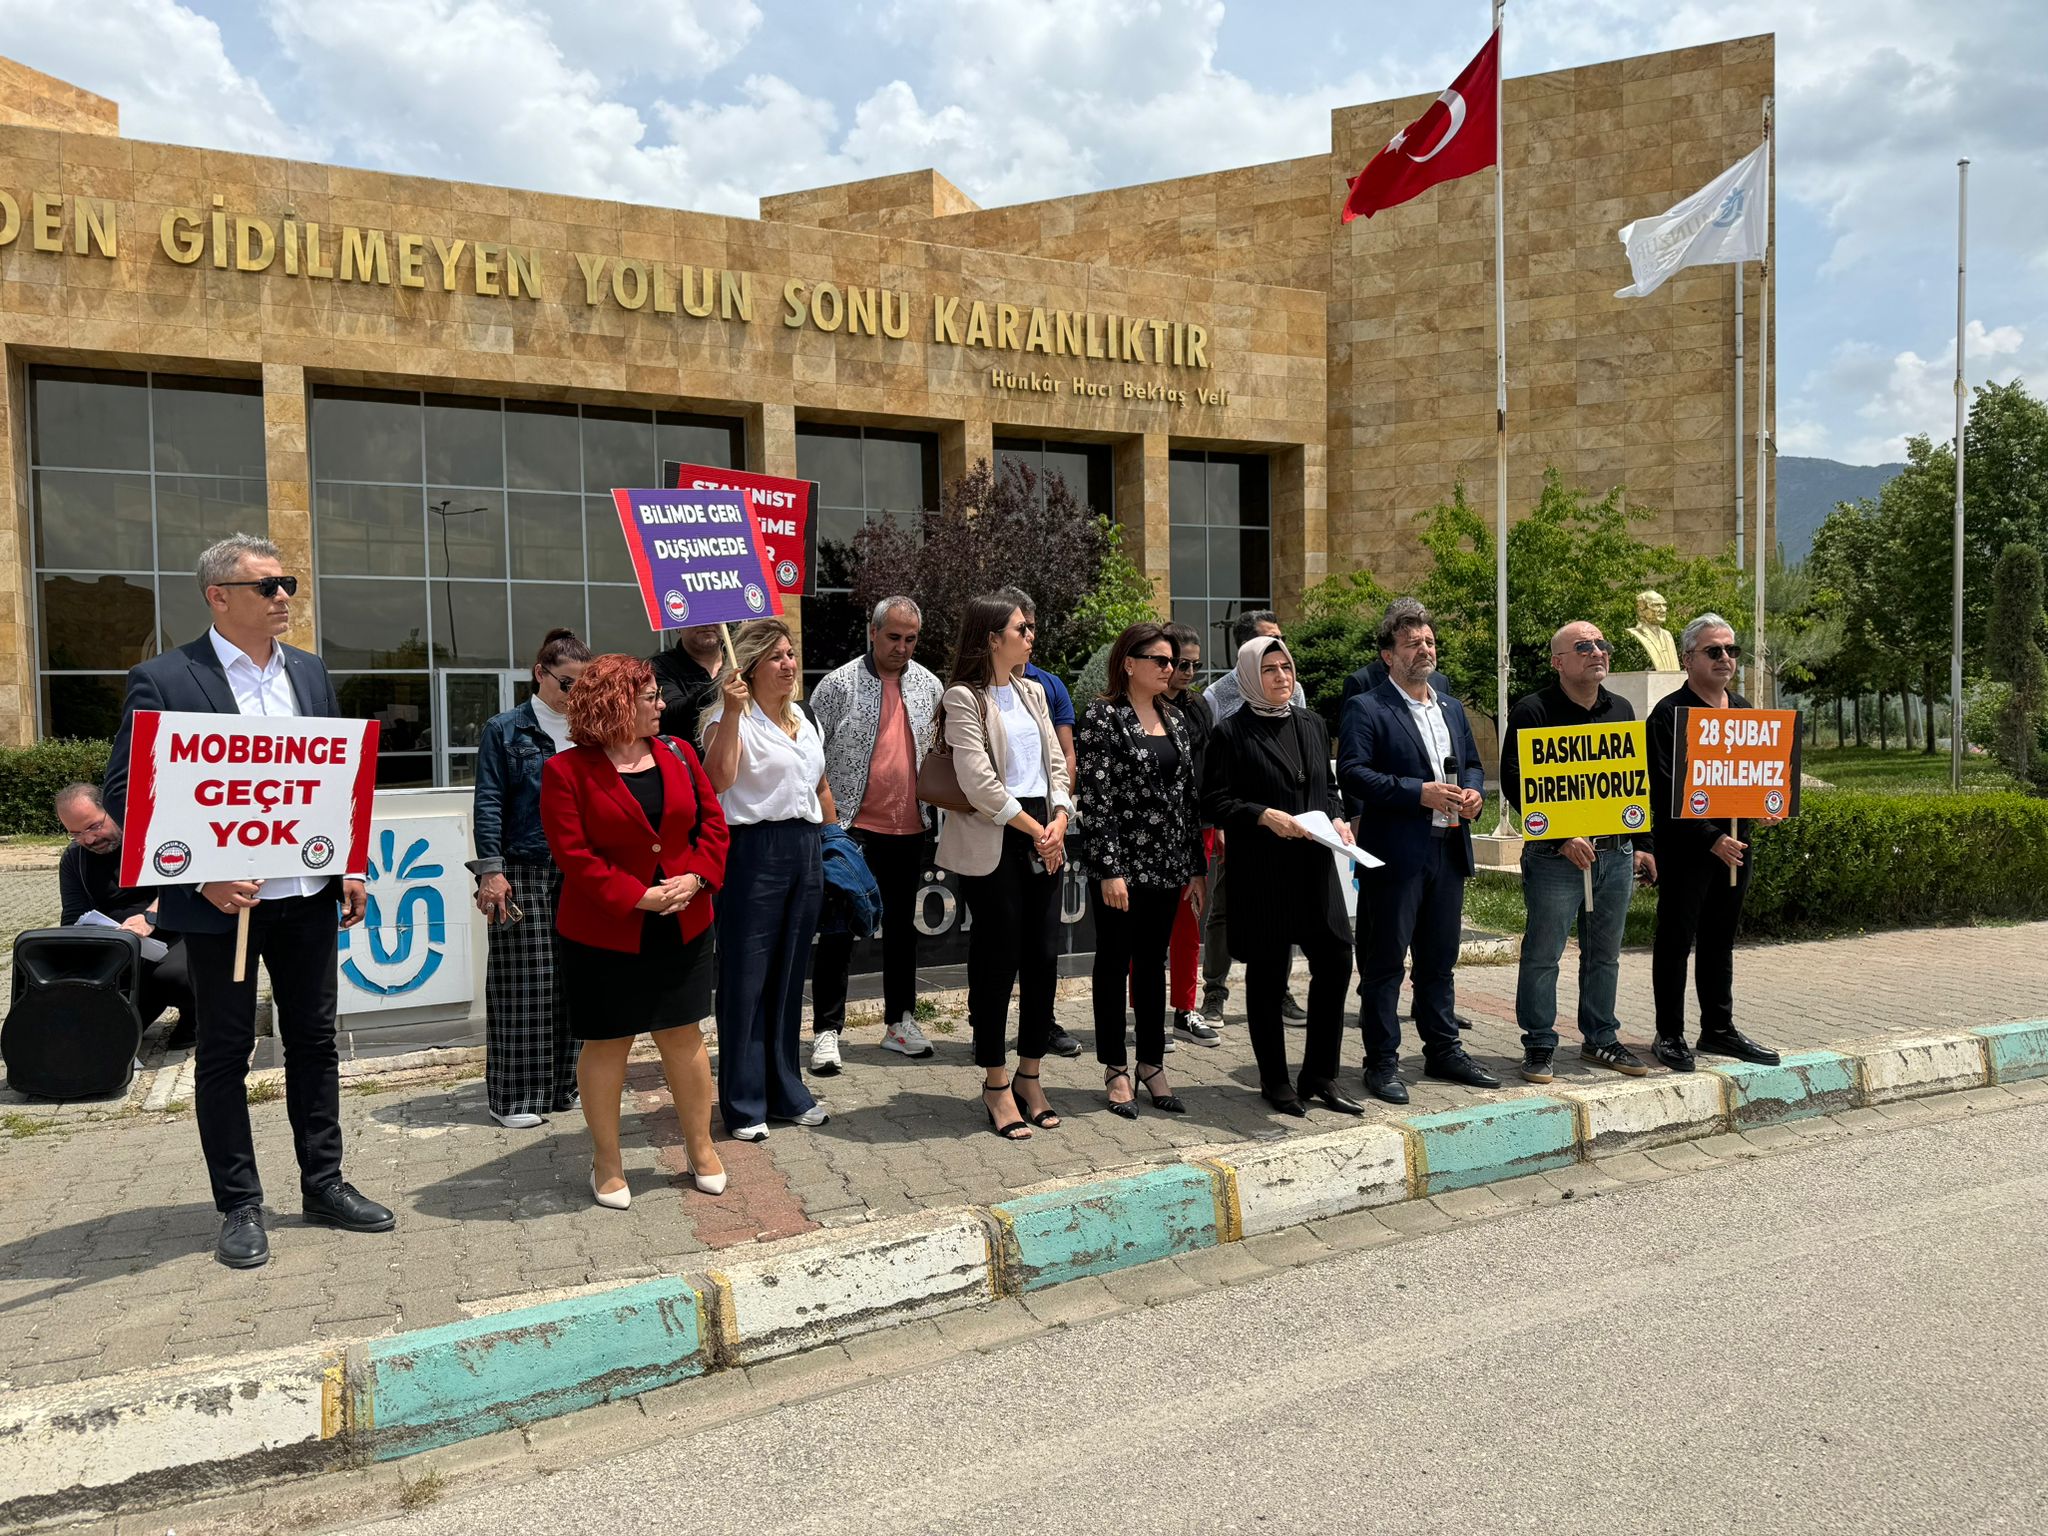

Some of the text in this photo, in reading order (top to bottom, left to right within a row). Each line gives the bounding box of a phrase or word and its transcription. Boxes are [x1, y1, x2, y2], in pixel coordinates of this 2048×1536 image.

[160, 194, 542, 300] GİDİLMEYEN
[573, 251, 754, 322] YOLUN
[784, 278, 910, 339] SONU
[991, 368, 1231, 408] Hünkâr Hacı Bektaş Veli
[653, 536, 748, 564] DÜŞÜNCEDE
[681, 570, 743, 592] TUTSAK
[1531, 731, 1636, 765] BASKILARA
[1699, 718, 1782, 754] 28 ŞUBAT
[209, 819, 300, 847] YOK
